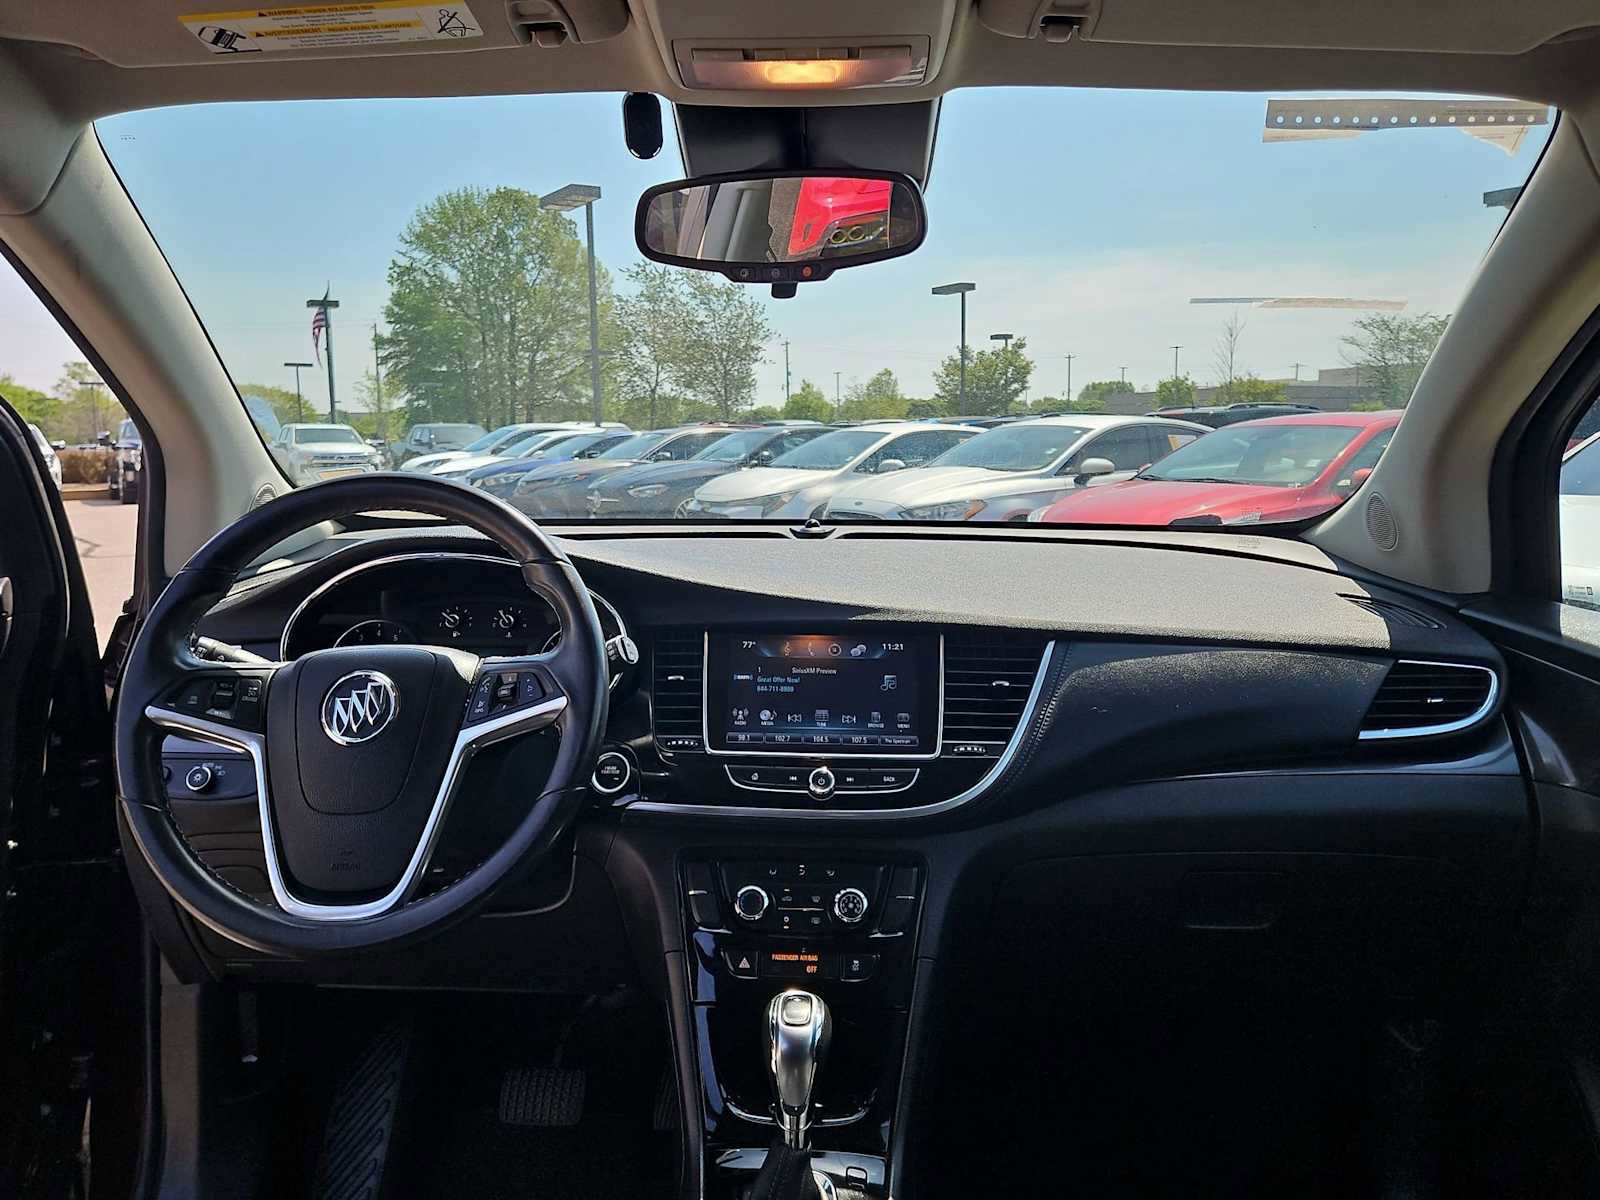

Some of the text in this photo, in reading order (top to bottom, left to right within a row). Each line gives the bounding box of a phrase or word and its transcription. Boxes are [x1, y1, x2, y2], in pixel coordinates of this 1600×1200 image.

[742, 640, 757, 649] 77°
[881, 642, 904, 651] 11:21
[791, 666, 838, 675] SiriusXM Preview
[787, 676, 801, 684] Now!
[851, 736, 868, 744] 107.5
[771, 953, 819, 962] PASSENGER AIRBAG
[806, 965, 818, 974] OFF
